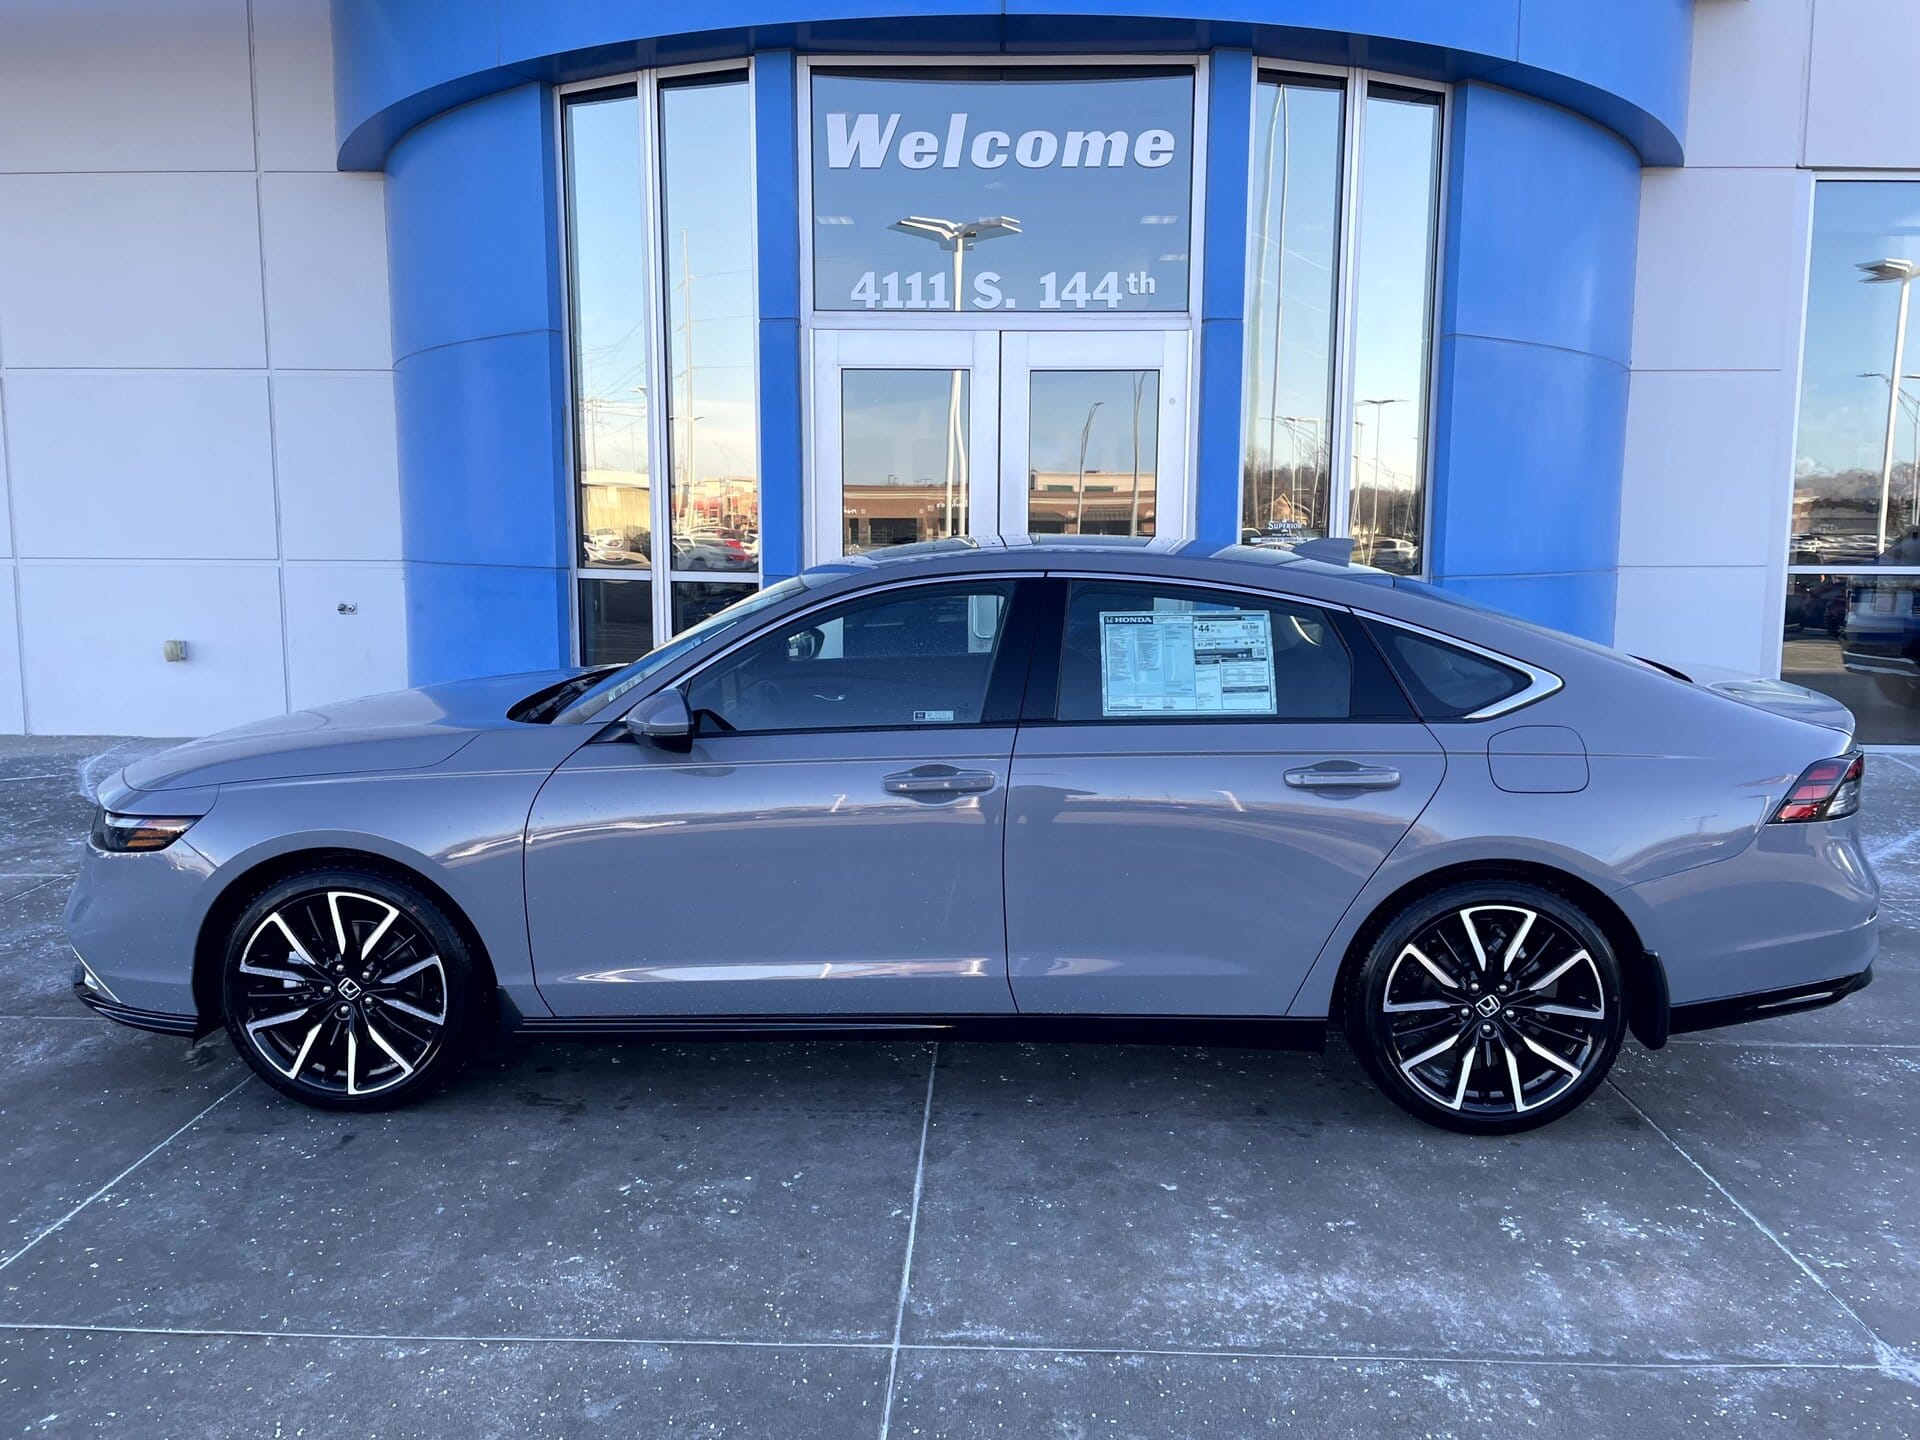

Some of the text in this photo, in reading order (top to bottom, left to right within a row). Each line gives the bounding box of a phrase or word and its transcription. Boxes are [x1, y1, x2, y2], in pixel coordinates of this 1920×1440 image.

[826, 113, 1175, 169] Welcome
[850, 271, 1156, 309] 4111 S. 144th
[1198, 624, 1210, 632] 44
